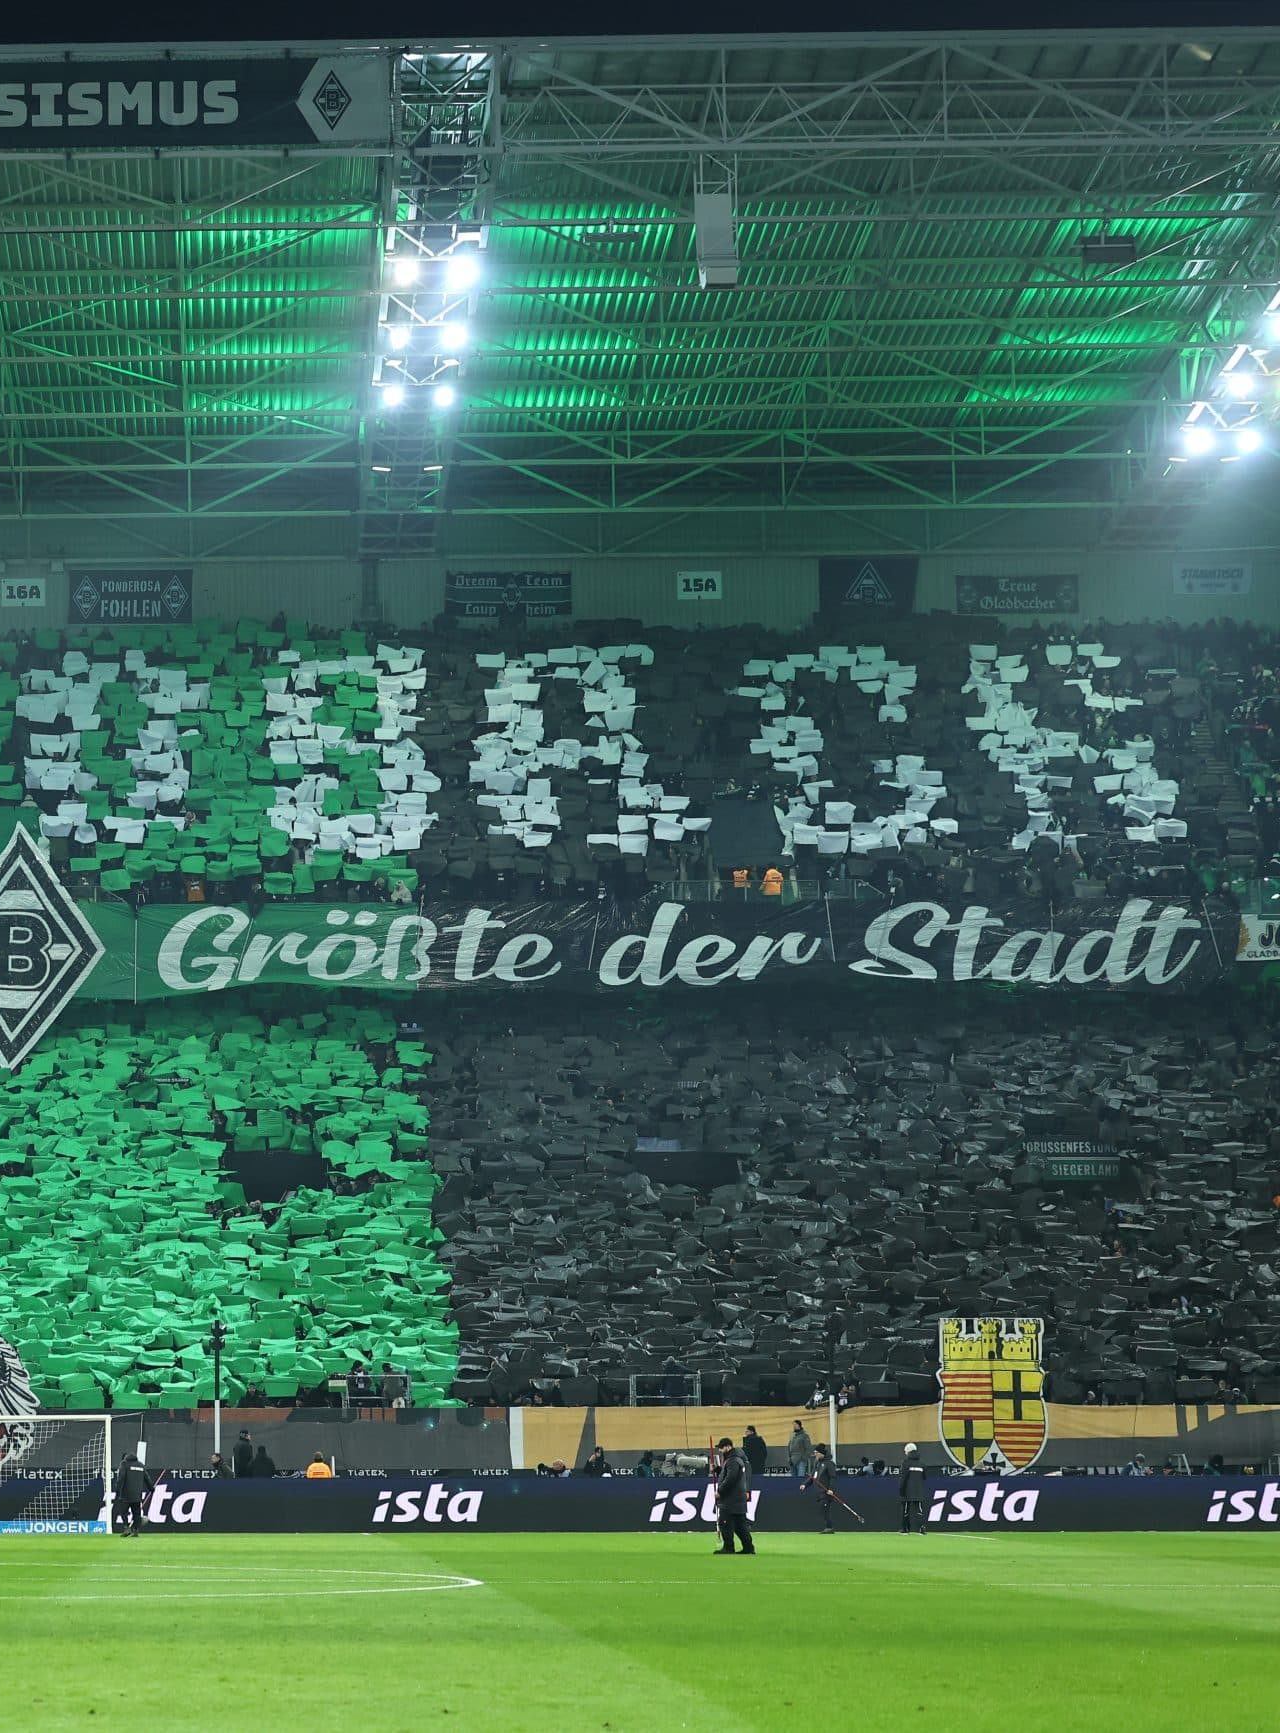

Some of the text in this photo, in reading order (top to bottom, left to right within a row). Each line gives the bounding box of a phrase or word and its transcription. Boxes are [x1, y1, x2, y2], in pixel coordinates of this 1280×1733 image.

[100, 580, 161, 593] PONDEROSA
[455, 575, 497, 587] Dream
[682, 578, 717, 593] 15A
[5, 585, 41, 600] 16A
[980, 596, 1056, 613] Gladbacher
[157, 899, 1201, 993] Größte der Stadt
[15, 1468, 63, 1480] flatex
[373, 1483, 484, 1523] ista
[927, 1482, 1040, 1522] ista
